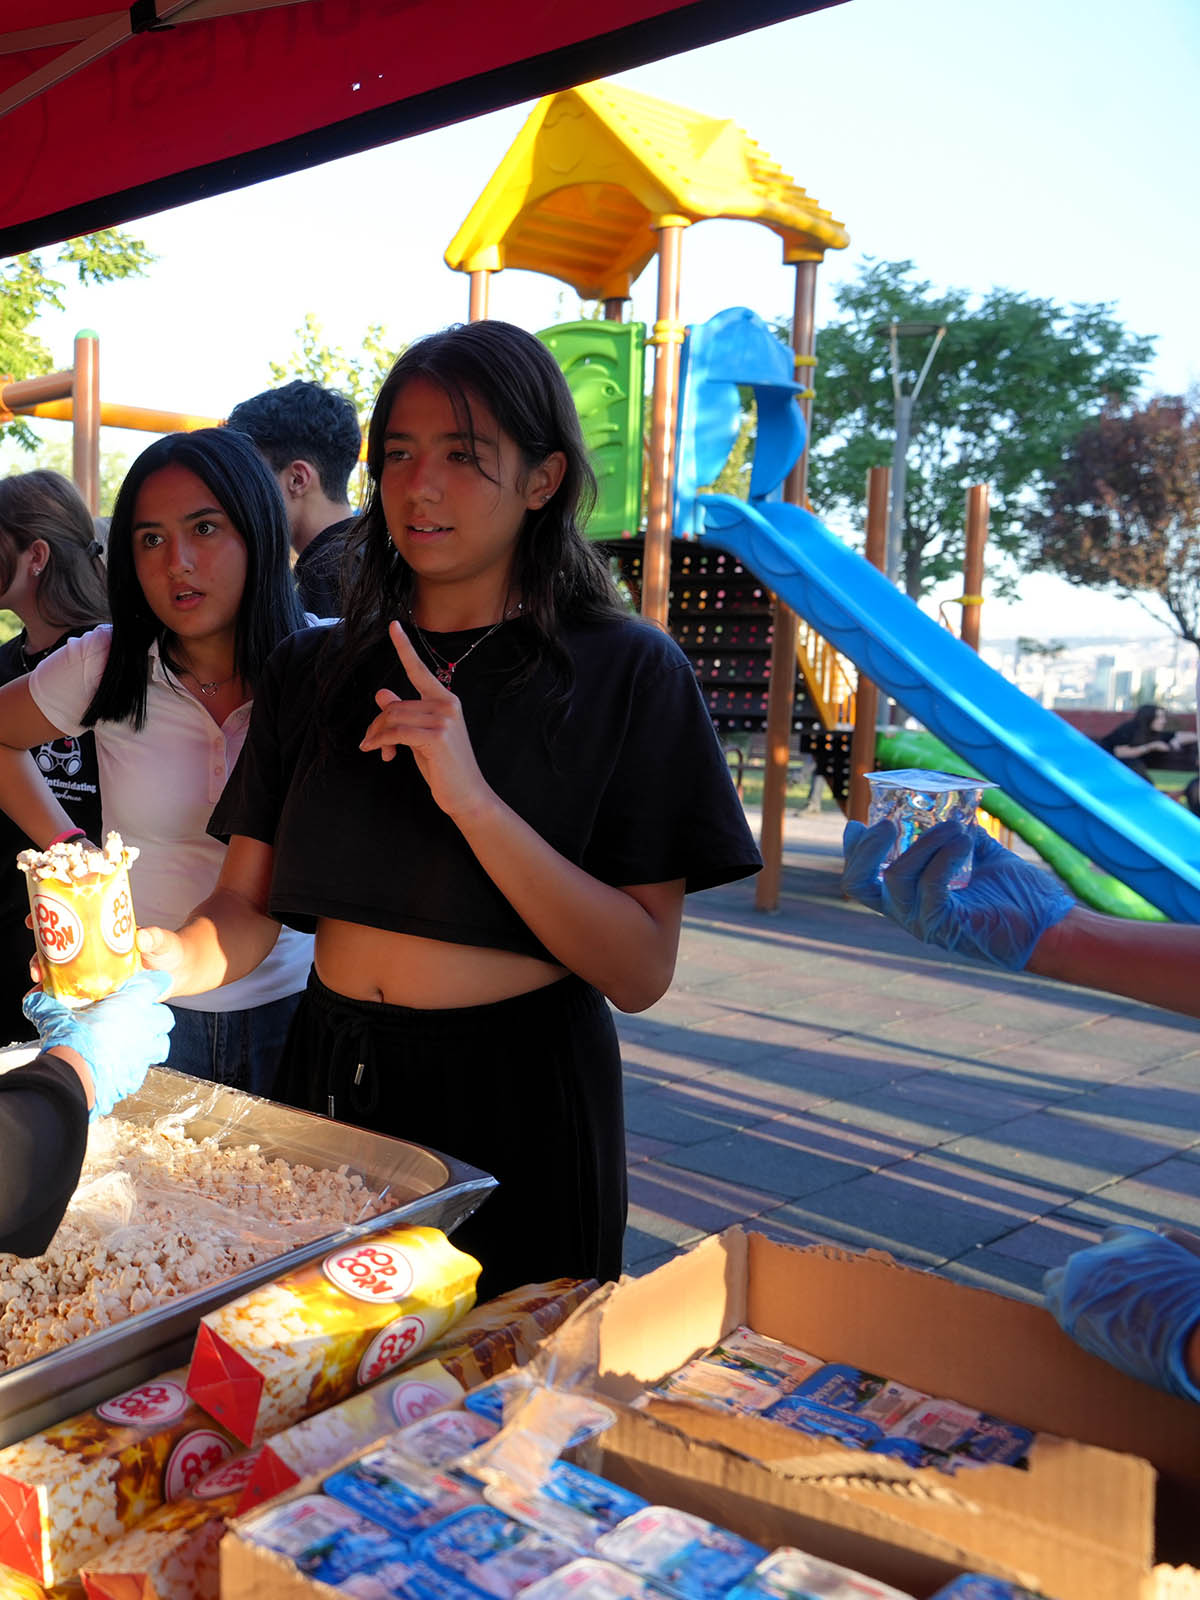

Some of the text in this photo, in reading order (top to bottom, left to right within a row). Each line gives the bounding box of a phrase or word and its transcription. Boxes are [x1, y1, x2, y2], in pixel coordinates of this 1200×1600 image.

[39, 925, 75, 952] CORN
[337, 1257, 395, 1295] CORN
[356, 1247, 398, 1277] POP
